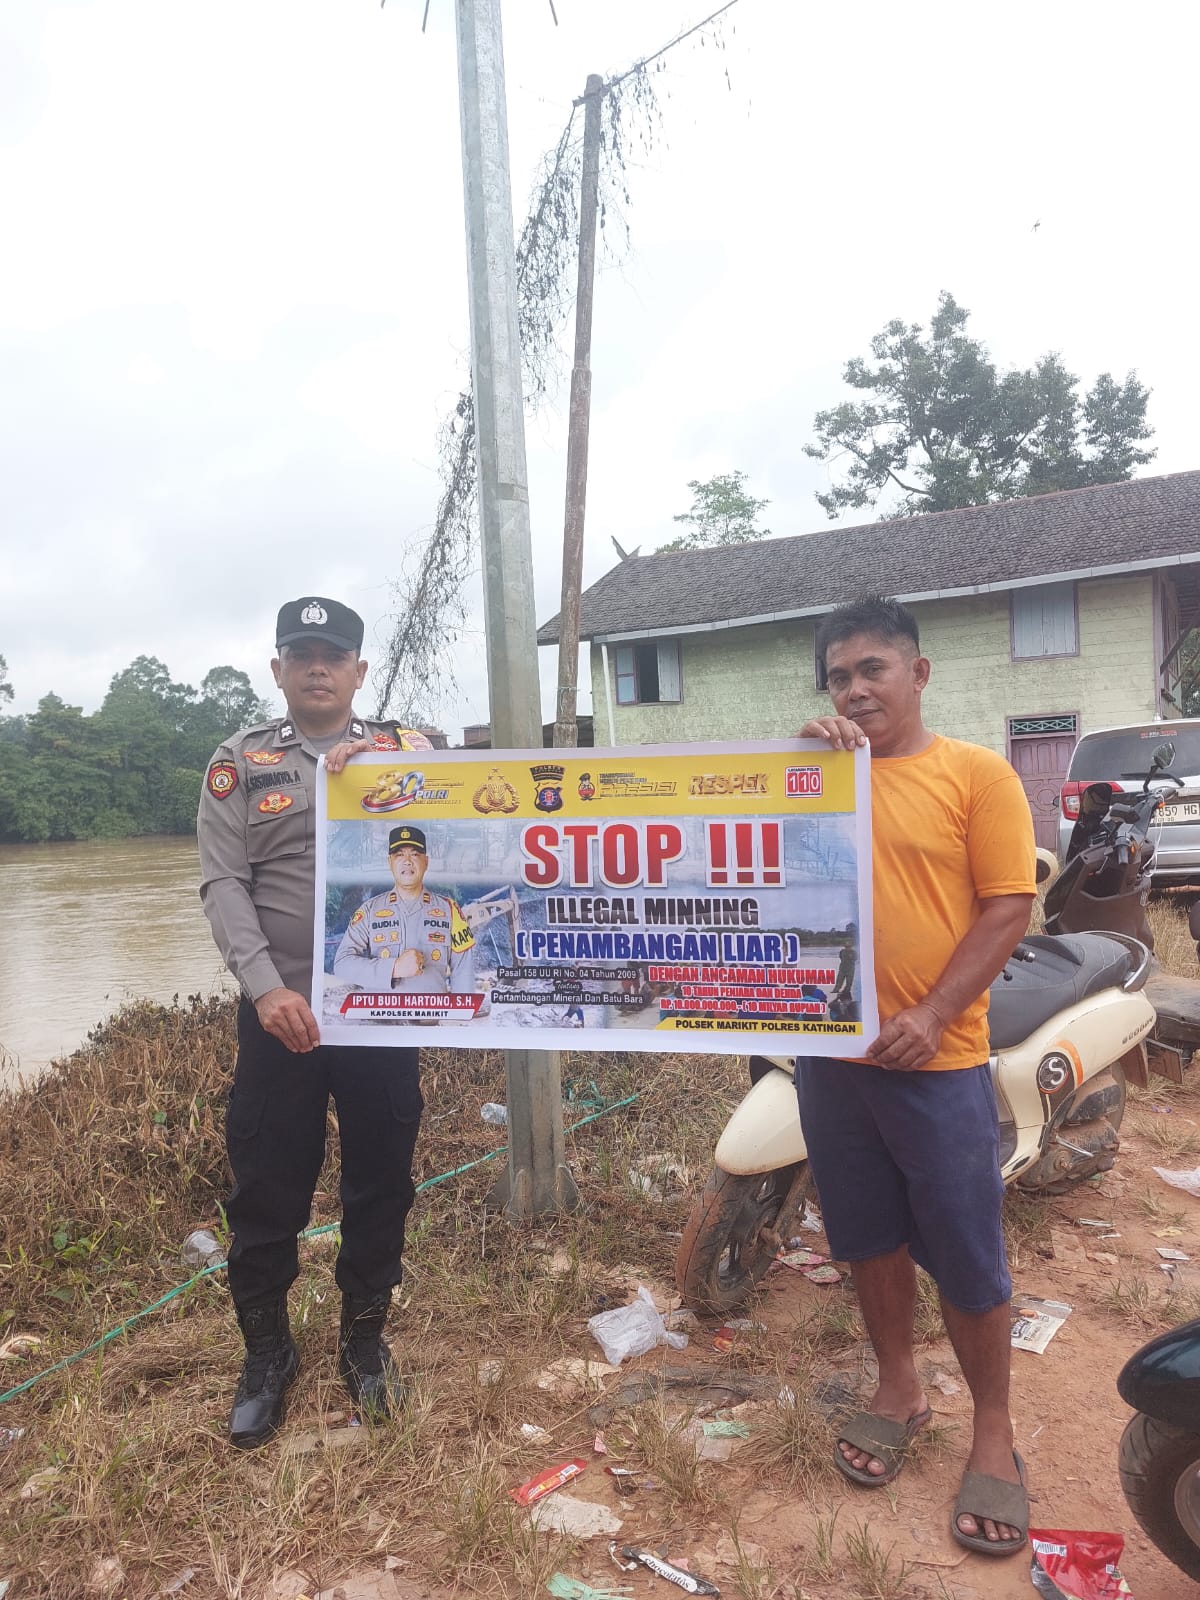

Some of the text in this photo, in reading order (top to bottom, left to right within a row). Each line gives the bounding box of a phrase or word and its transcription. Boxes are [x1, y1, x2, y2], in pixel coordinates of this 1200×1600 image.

[688, 773, 769, 796] RESPEK
[788, 774, 820, 792] 110
[415, 789, 450, 800] POLRI
[523, 823, 683, 885] STOP
[546, 896, 760, 927] ILLEGAL MINNING
[371, 919, 400, 930] BUDI.H
[423, 919, 450, 929] POLRI
[531, 932, 718, 961] PENAMBANGAN
[723, 933, 782, 962] LIAR
[499, 968, 637, 979] Pasal 158 UU RI No. 04 Tahun 2009
[648, 966, 836, 985] DENGAN ANCAMAN HUKUMAN
[493, 992, 643, 1004] Pertambangan Mineral Dan Batu Bara
[682, 986, 802, 999] 10 TAHUN PENJARA DAN DENDA
[352, 995, 475, 1008] IPTU BUDI HARTONO, S.H.
[675, 1020, 856, 1033] POLSEK MARIKIT POLRES KATINGAN
